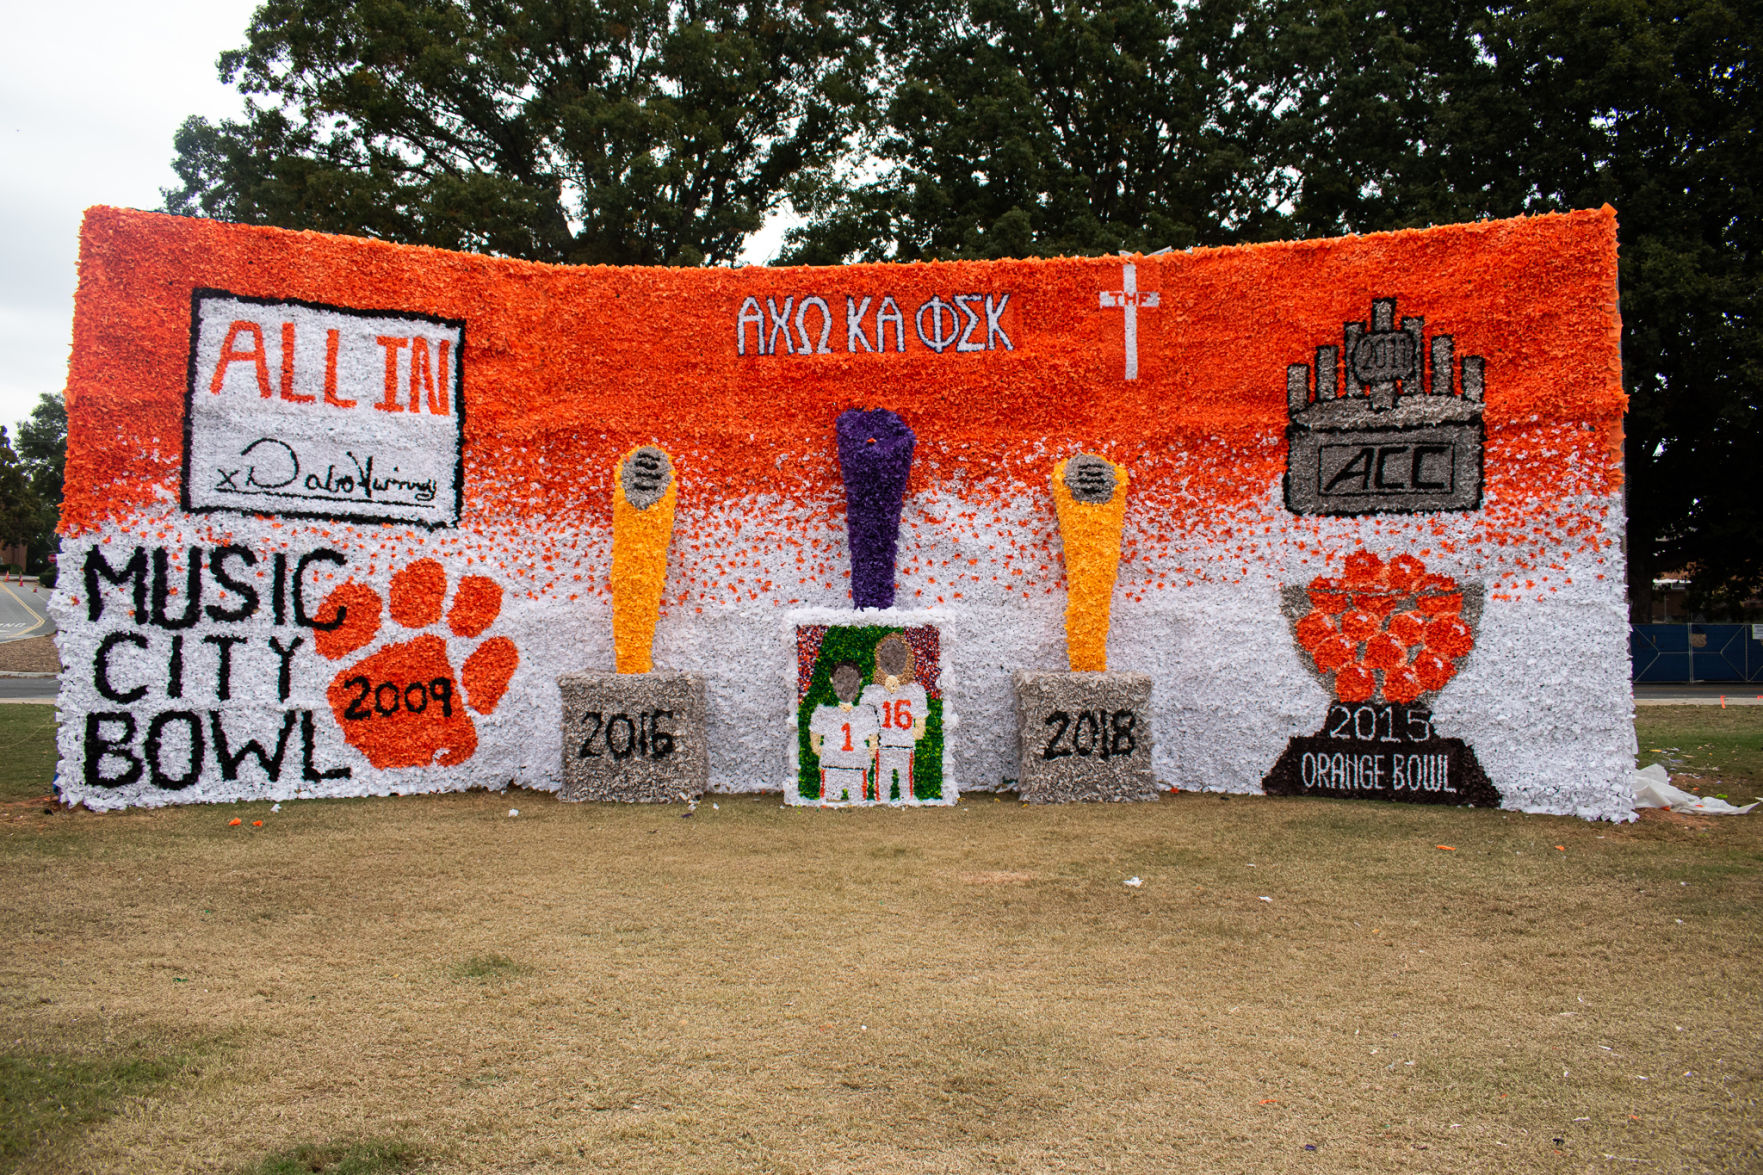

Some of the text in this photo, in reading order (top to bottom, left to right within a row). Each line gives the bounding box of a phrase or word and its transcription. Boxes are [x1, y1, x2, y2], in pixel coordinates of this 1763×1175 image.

[209, 319, 451, 416] ALL IN
[1322, 446, 1450, 491] ACC
[83, 544, 347, 631] MUSIC
[95, 631, 302, 703] CITY
[343, 676, 453, 722] 2009
[882, 698, 914, 731] 16
[1329, 704, 1431, 743] 2015
[84, 710, 351, 790] BOWL
[578, 708, 675, 761] 2016
[840, 722, 855, 753] 1
[1043, 707, 1137, 761] 2018
[1301, 752, 1457, 793] ORANGE BOWL
